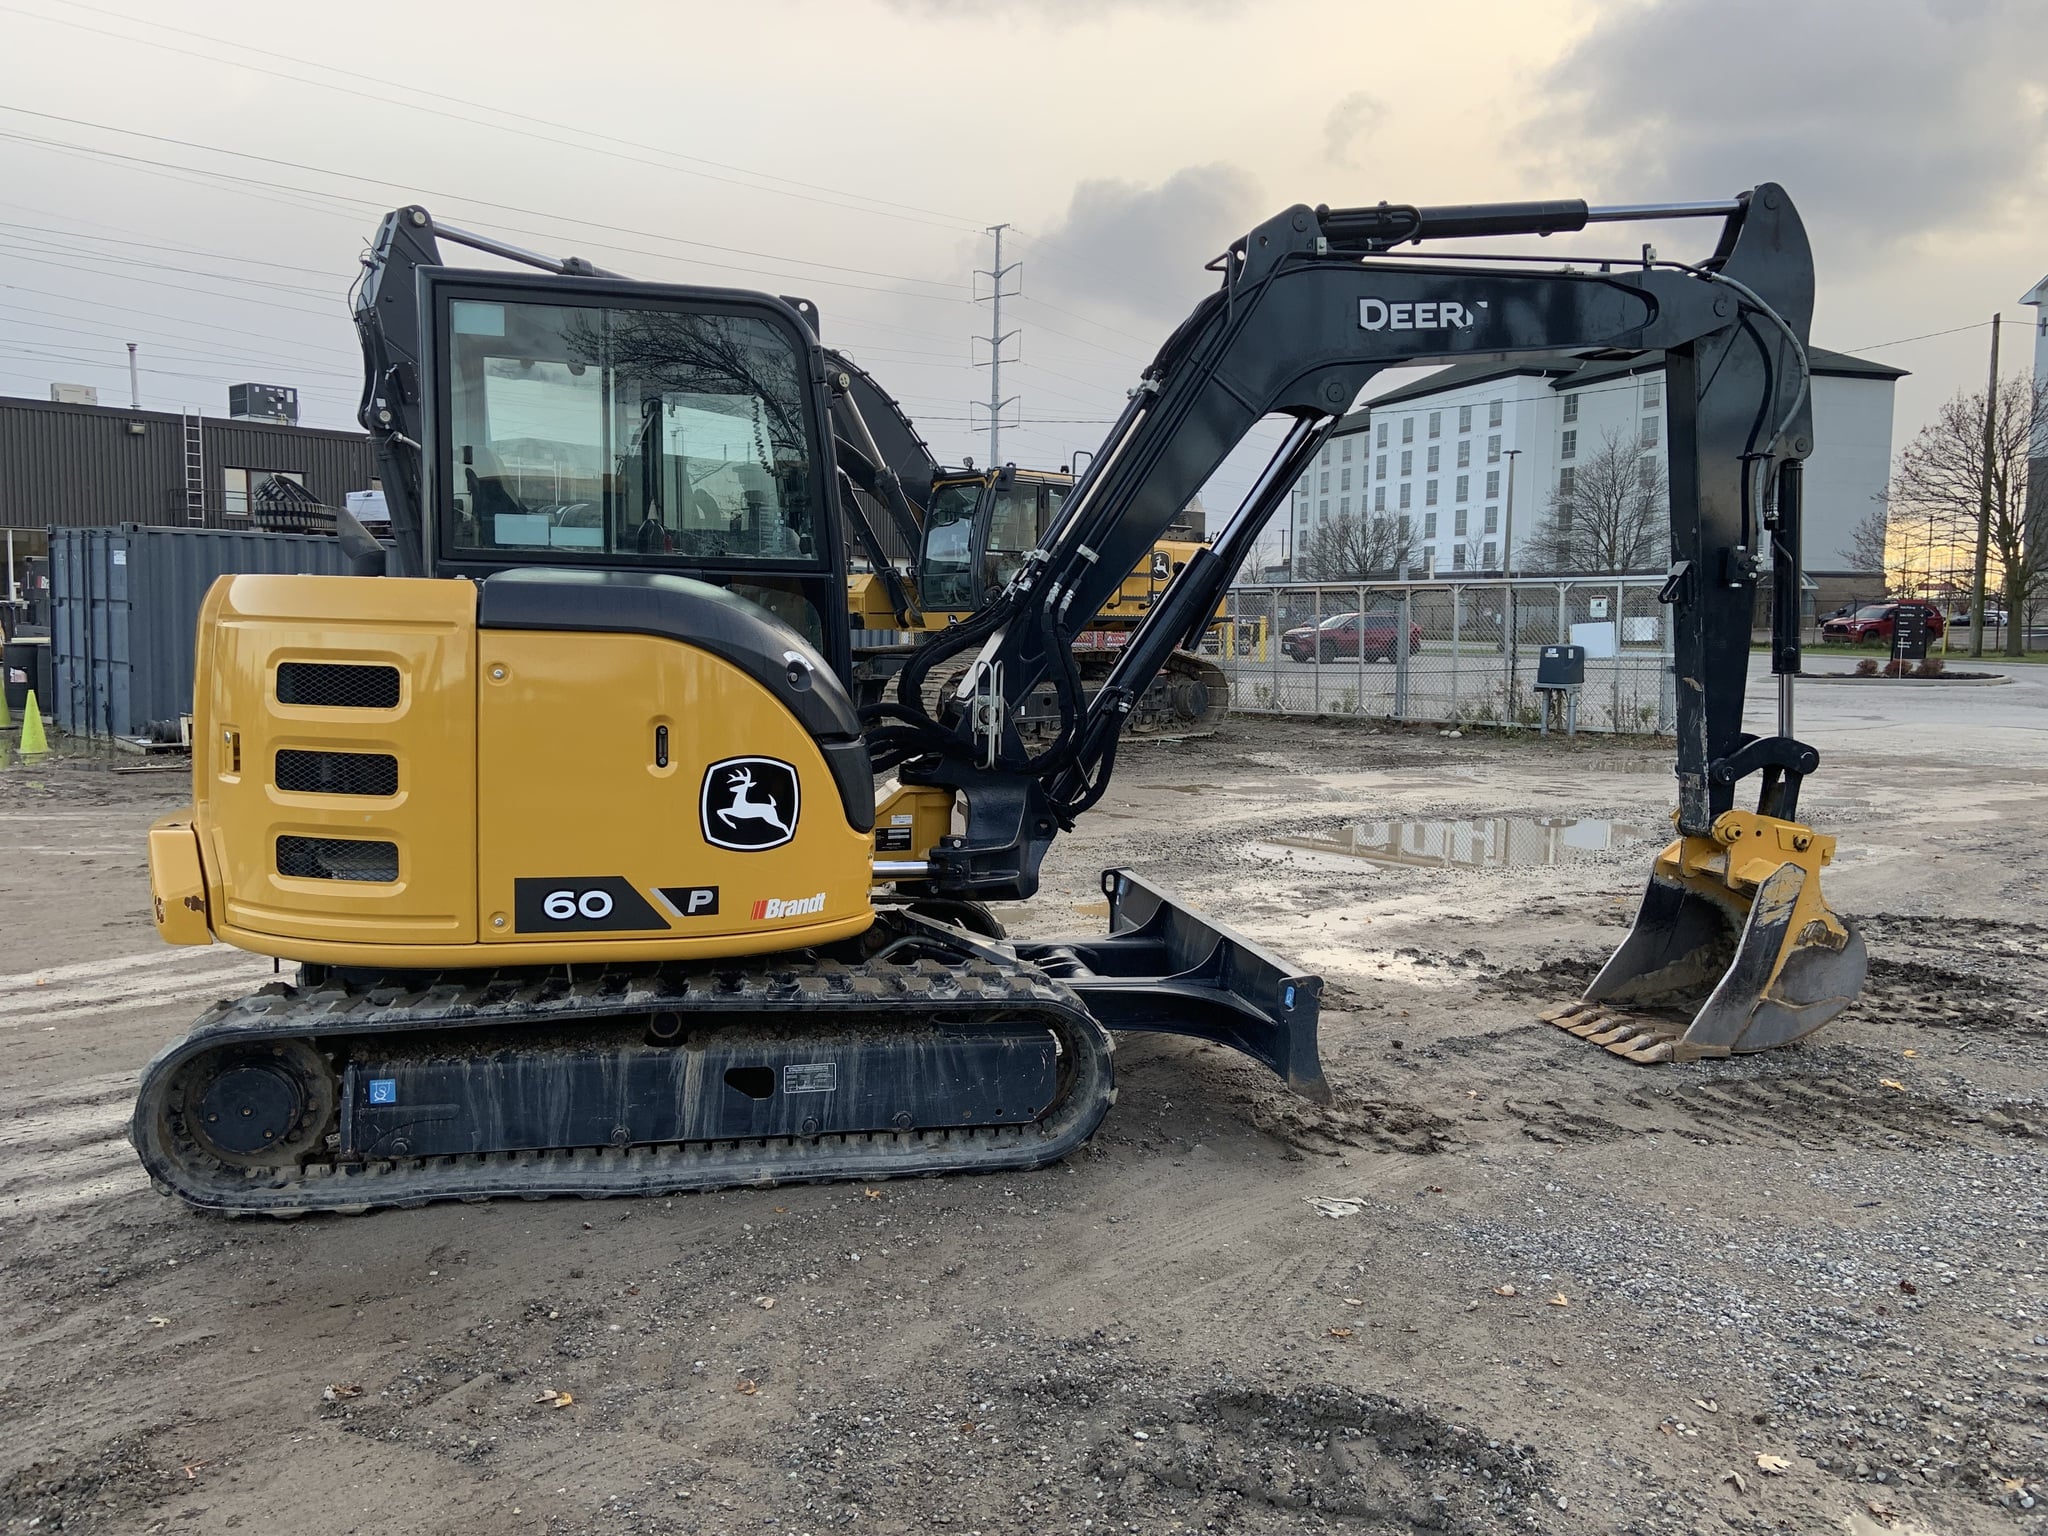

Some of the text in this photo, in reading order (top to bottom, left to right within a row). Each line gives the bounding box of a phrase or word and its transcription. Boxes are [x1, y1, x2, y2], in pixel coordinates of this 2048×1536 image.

[543, 889, 714, 919] 60 P
[765, 892, 826, 919] Brandt
